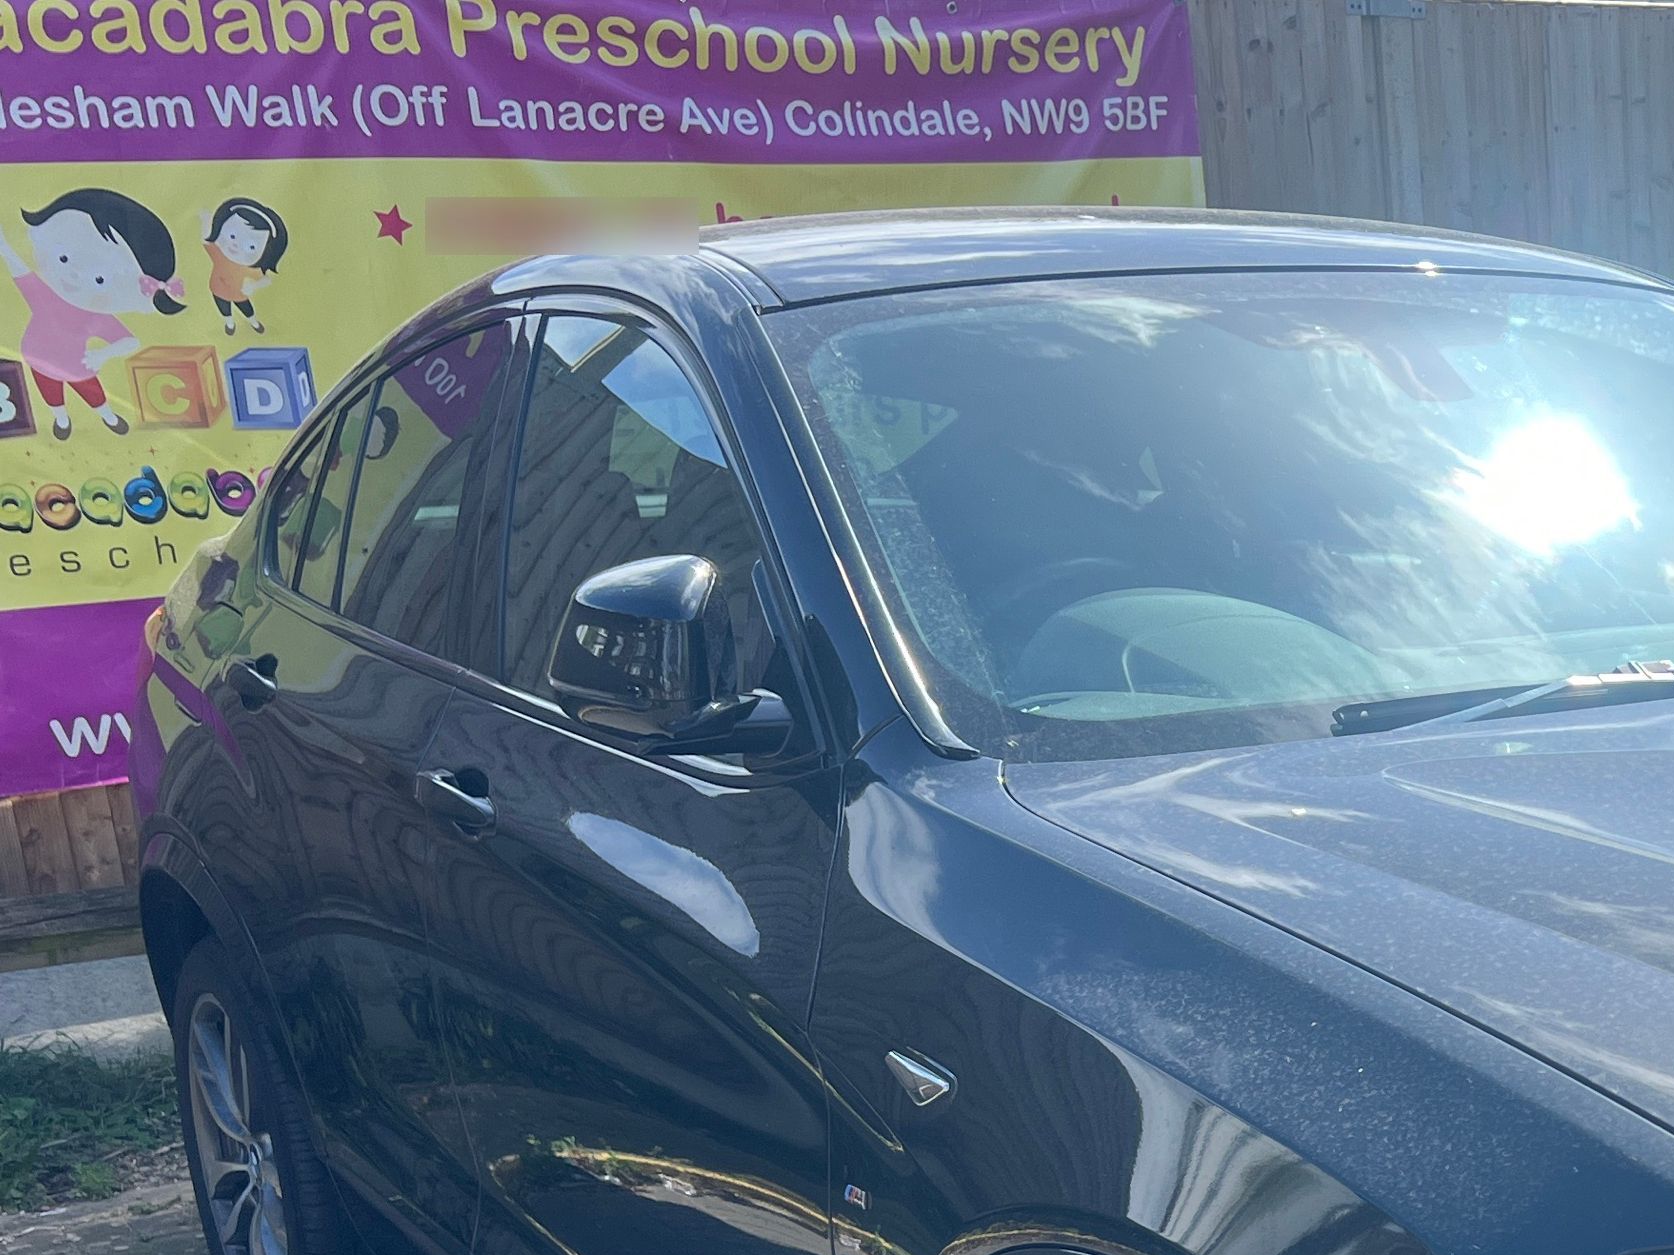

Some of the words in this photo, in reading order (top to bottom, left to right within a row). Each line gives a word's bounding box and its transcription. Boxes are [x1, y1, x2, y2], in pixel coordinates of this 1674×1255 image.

[446, 0, 857, 76] Preschool
[873, 14, 1146, 87] Nursery
[204, 83, 339, 129] Walk
[352, 83, 448, 138] (Off
[467, 85, 666, 133] Lanacre
[680, 97, 774, 145] Ave)
[784, 99, 993, 142] Colindale,
[1001, 97, 1091, 136] NW9
[1103, 95, 1169, 132] 5BF
[146, 373, 191, 416] C
[243, 378, 284, 416] D
[0, 465, 272, 534] acadab
[48, 711, 132, 758] w
